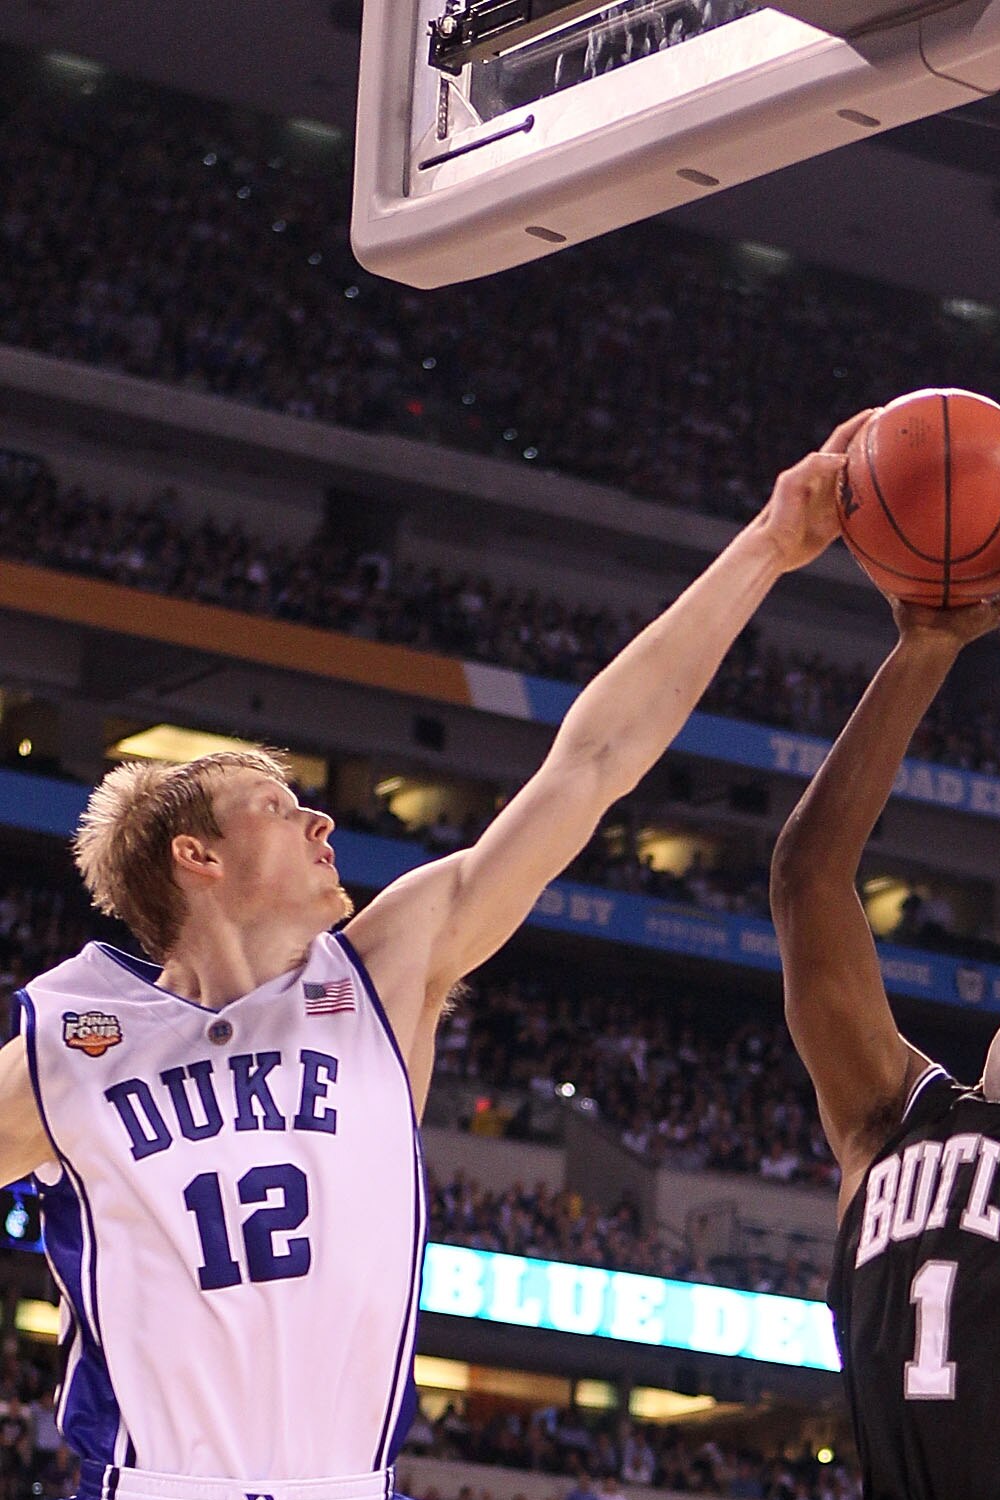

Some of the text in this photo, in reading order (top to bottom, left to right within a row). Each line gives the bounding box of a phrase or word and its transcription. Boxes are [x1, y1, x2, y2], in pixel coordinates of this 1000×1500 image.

[65, 1022, 119, 1040] FOUR
[104, 1049, 338, 1161] DUKE
[183, 1163, 311, 1291] 12
[425, 1244, 666, 1346] BLUE
[904, 1259, 959, 1400] 1
